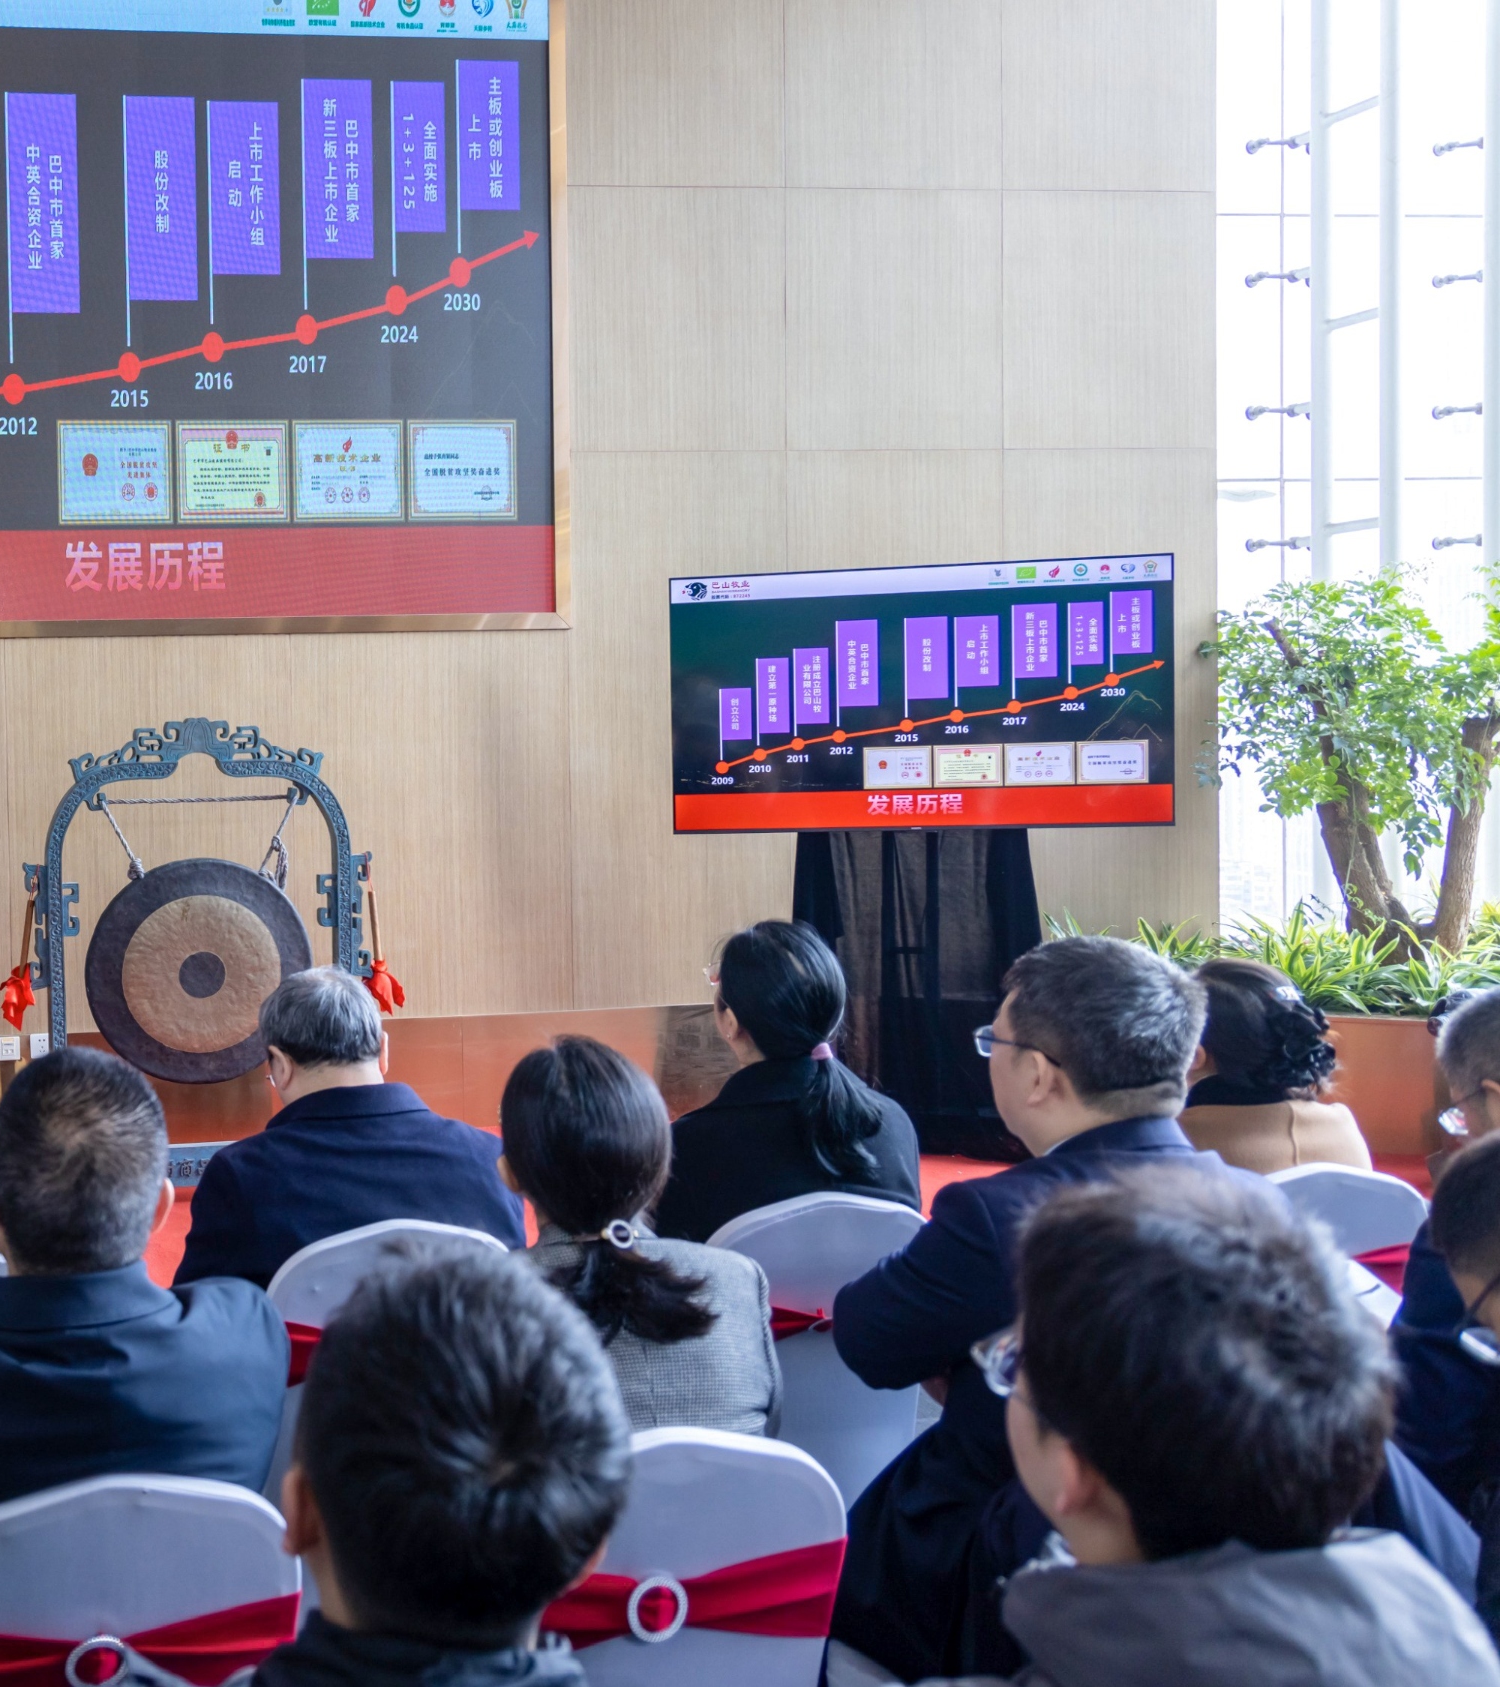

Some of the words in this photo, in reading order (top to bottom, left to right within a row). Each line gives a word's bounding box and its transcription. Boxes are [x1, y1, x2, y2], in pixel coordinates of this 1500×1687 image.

[467, 113, 482, 161] 上市
[488, 76, 504, 199] 主板或创业板
[322, 98, 339, 243] 新三板上市企业
[345, 119, 360, 223] 巴中市首家
[423, 120, 438, 203] 全面实施
[154, 149, 170, 234] 股份改制
[227, 159, 242, 208] 启动
[248, 121, 265, 246] 上市工作小组
[25, 142, 43, 270] 中英合资企业
[48, 154, 65, 260] 巴中市首家
[443, 293, 481, 312] 2030
[380, 324, 419, 344] 2024
[194, 371, 234, 391] 2016
[288, 355, 327, 374] 2017
[110, 389, 149, 408] 2015
[313, 453, 381, 463] 高新技术企业
[63, 540, 227, 592] 发展历程
[711, 580, 751, 589] 巴山牧业
[1088, 617, 1099, 653] 全面实施
[1117, 613, 1127, 634] 上市
[1131, 597, 1141, 649] 主板或创业板
[922, 638, 932, 672] 股份改制
[966, 639, 976, 660] 启动
[979, 624, 989, 675] 上市工作小组
[1025, 611, 1035, 672] 新三板上市企业
[1038, 619, 1049, 663] 巴中市首家
[847, 639, 857, 690] 中英合资企业
[860, 643, 870, 686] 巴中市首家
[767, 664, 778, 723] 建立第一原种场
[802, 664, 812, 705] 业有限公司
[812, 655, 822, 713] 注册成立巴山牧
[1100, 687, 1126, 697] 2030
[730, 697, 740, 731] 创立公司
[1002, 716, 1027, 726] 2017
[1059, 702, 1086, 712] 2024
[894, 733, 919, 743] 2015
[944, 724, 970, 734] 2016
[786, 754, 809, 764] 2011
[829, 746, 854, 756] 2012
[711, 776, 734, 786] 2009
[748, 764, 772, 774] 2010
[867, 792, 963, 817] 发展历程
